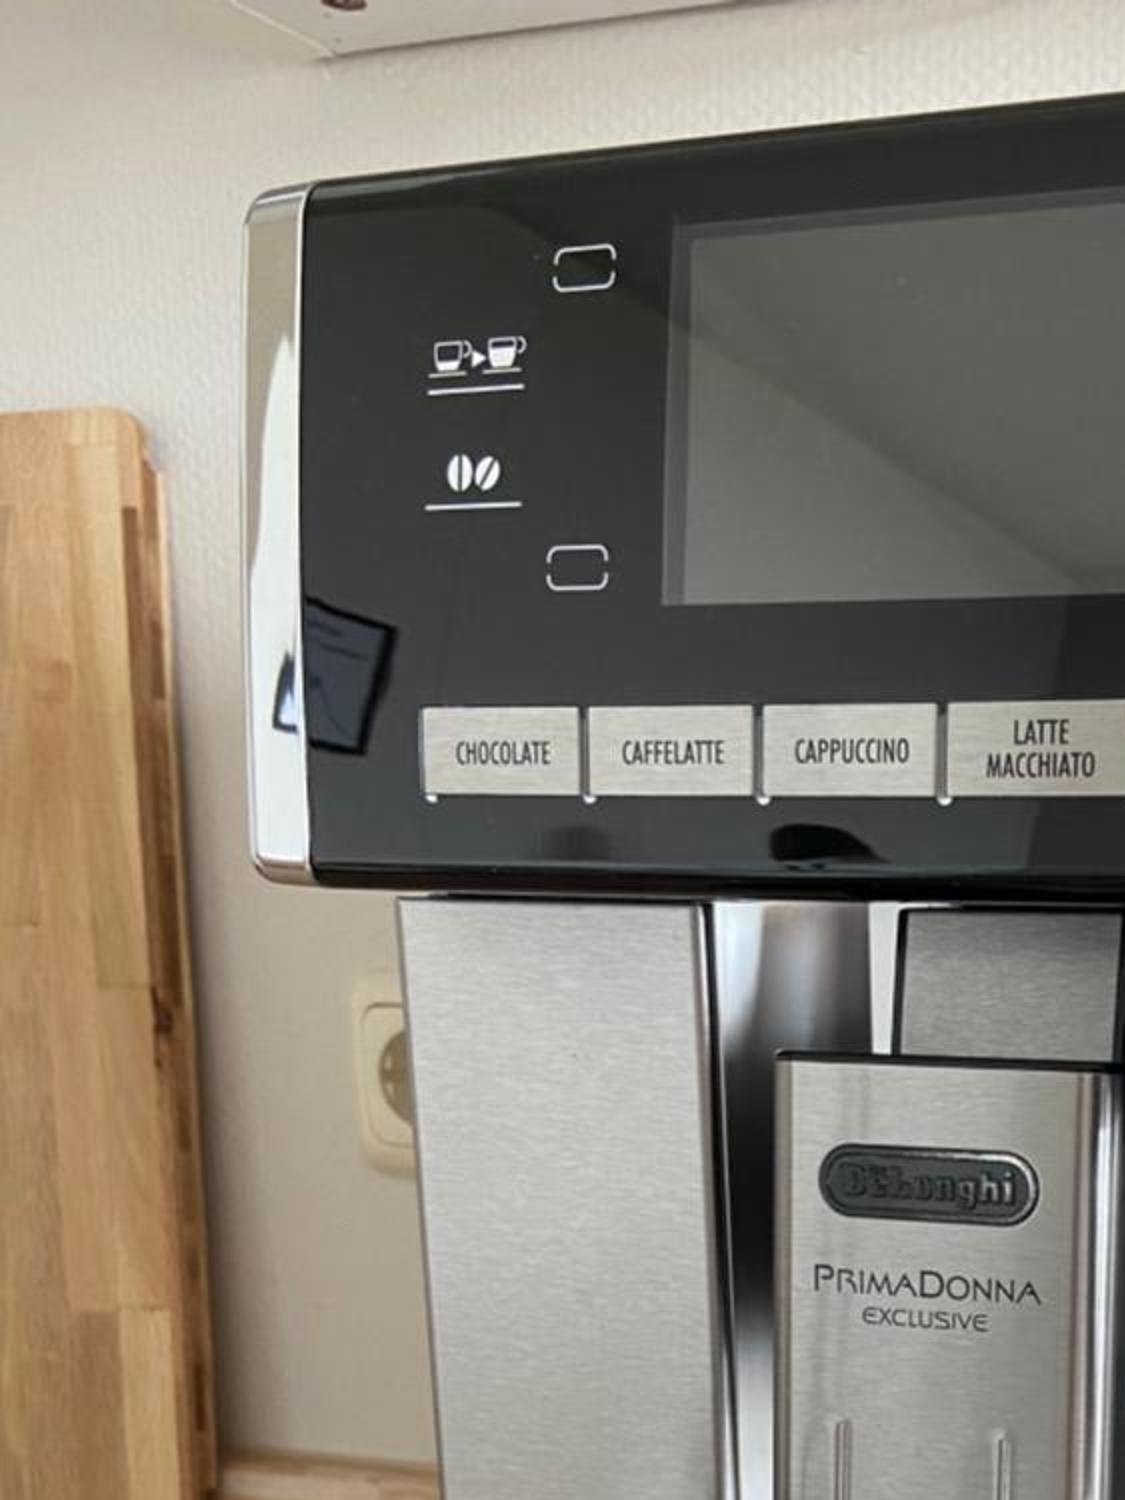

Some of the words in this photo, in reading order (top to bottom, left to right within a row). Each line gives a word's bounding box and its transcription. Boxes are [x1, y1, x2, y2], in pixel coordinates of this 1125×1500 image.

[1013, 719, 1069, 746] LATTE
[456, 740, 551, 765] CHOCOLATE
[621, 739, 724, 765] CAFFELATTE
[794, 737, 910, 765] CAPPUCCINO
[985, 752, 1095, 778] MACCHIATO
[861, 1305, 990, 1332] EXCLUSIVE
